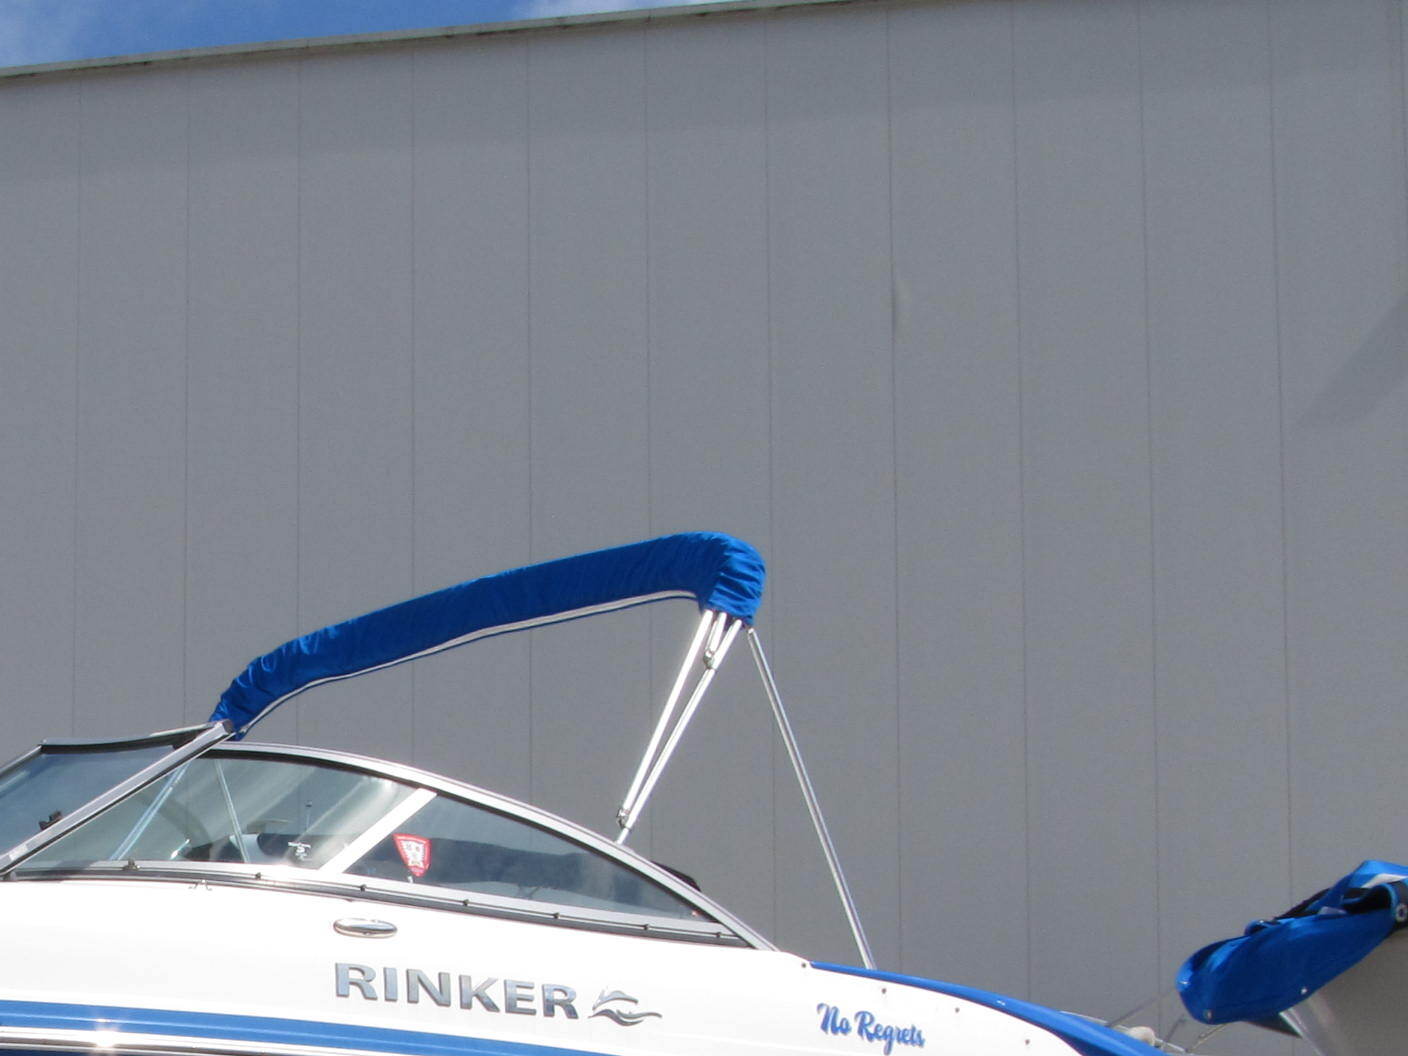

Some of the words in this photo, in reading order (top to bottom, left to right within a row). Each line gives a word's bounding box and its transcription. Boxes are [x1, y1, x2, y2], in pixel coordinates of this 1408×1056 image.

[335, 962, 579, 1020] RINKER
[816, 1002, 852, 1036] No
[853, 1010, 926, 1056] Regrets
